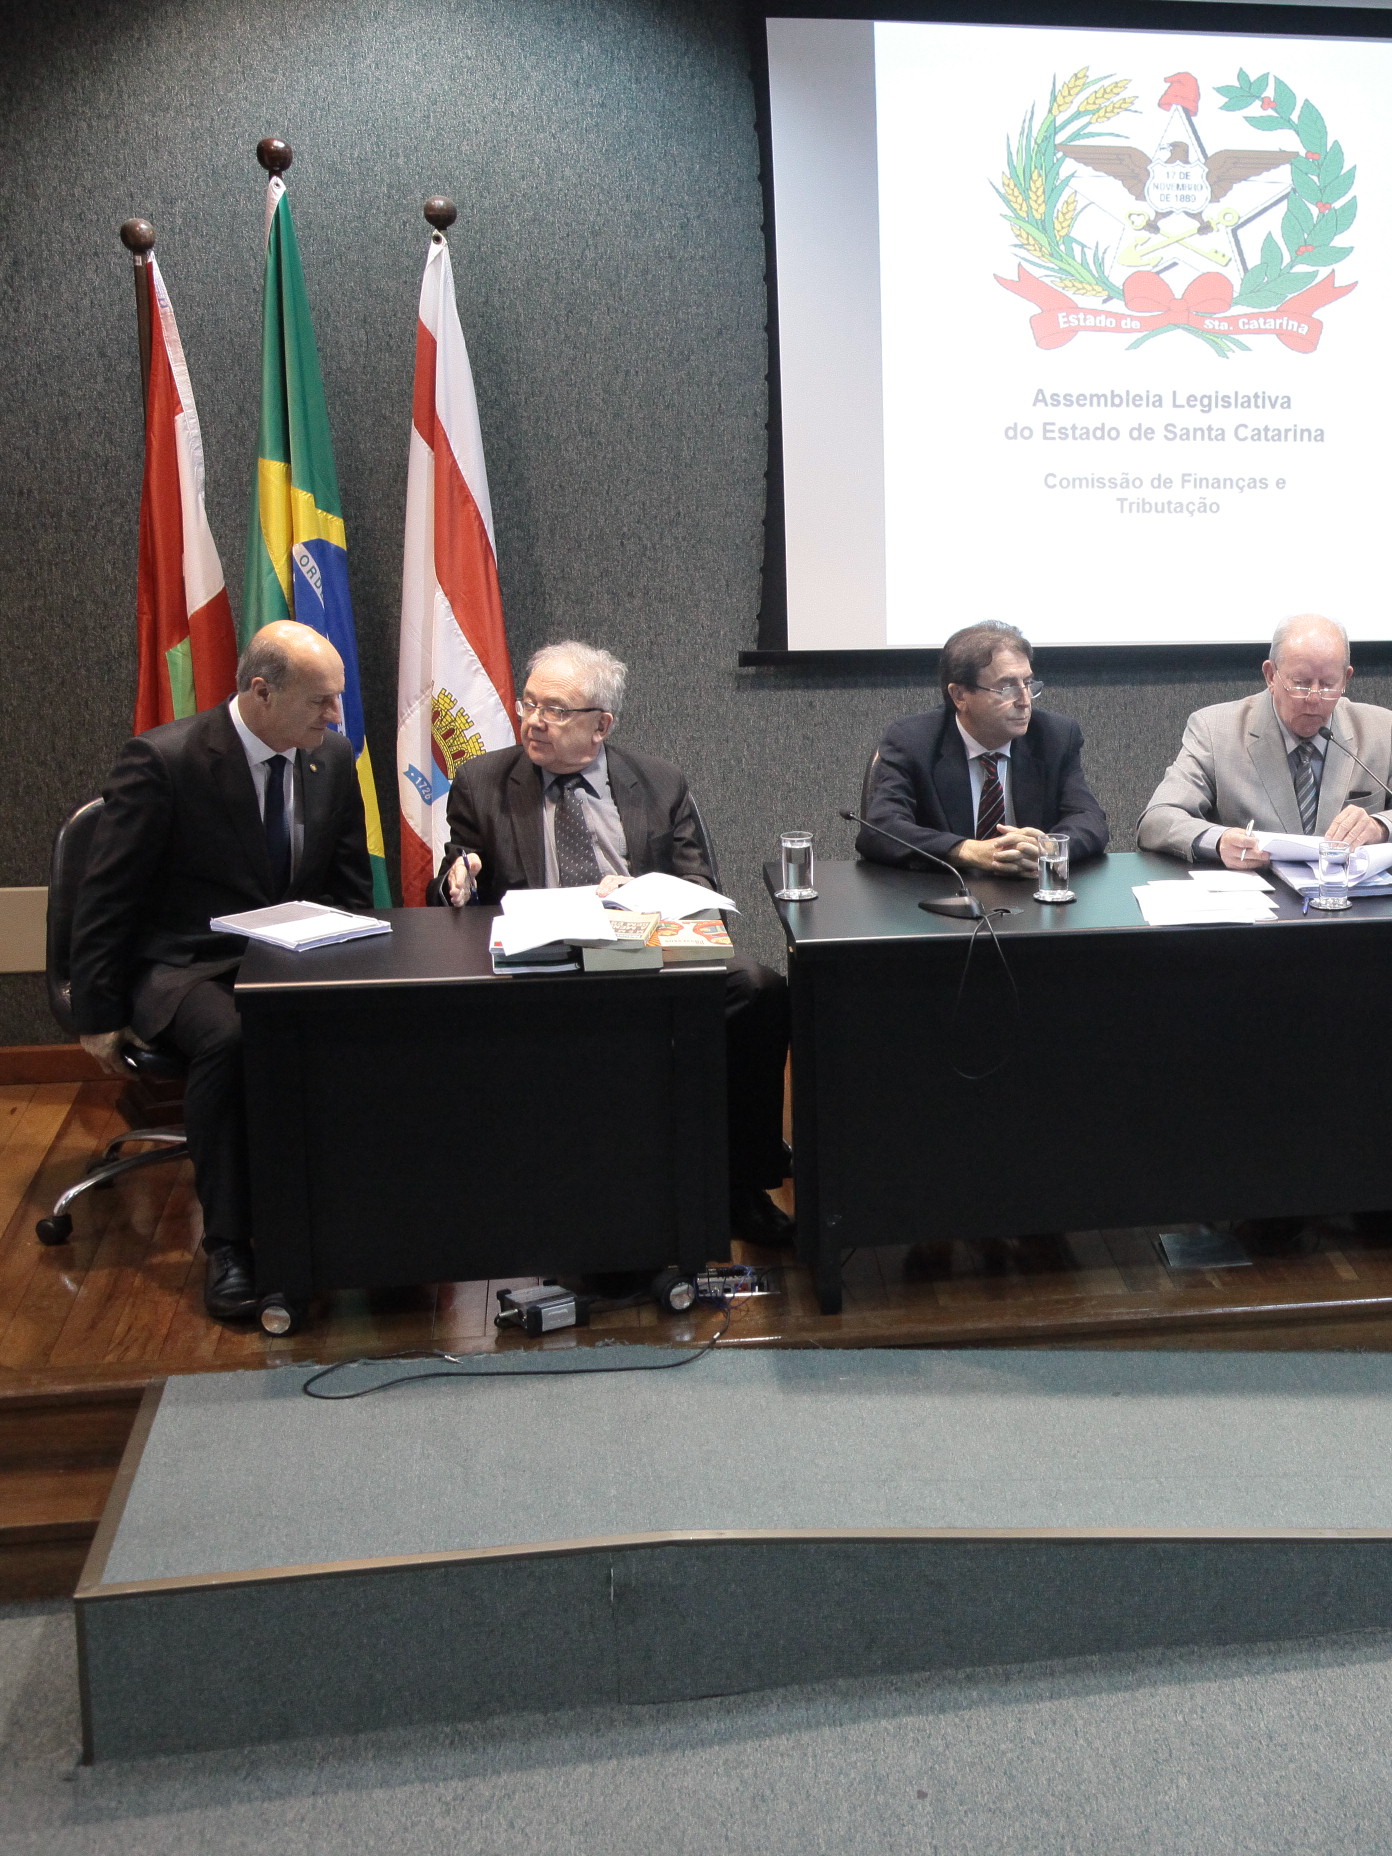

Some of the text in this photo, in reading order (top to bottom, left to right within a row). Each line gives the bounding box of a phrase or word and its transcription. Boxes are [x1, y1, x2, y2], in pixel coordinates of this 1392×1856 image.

[1179, 171, 1191, 180] DE
[1160, 193, 1197, 203] DE 1889
[1057, 312, 1309, 335] Estado de Sta. Catarina
[1032, 388, 1292, 413] Assembleia Legislativa
[1004, 422, 1325, 443] do Estado de Santa Catarina
[1044, 472, 1287, 493] Comissão de Finanças e
[1116, 497, 1221, 517] Tributação
[415, 776, 432, 800] 1726
